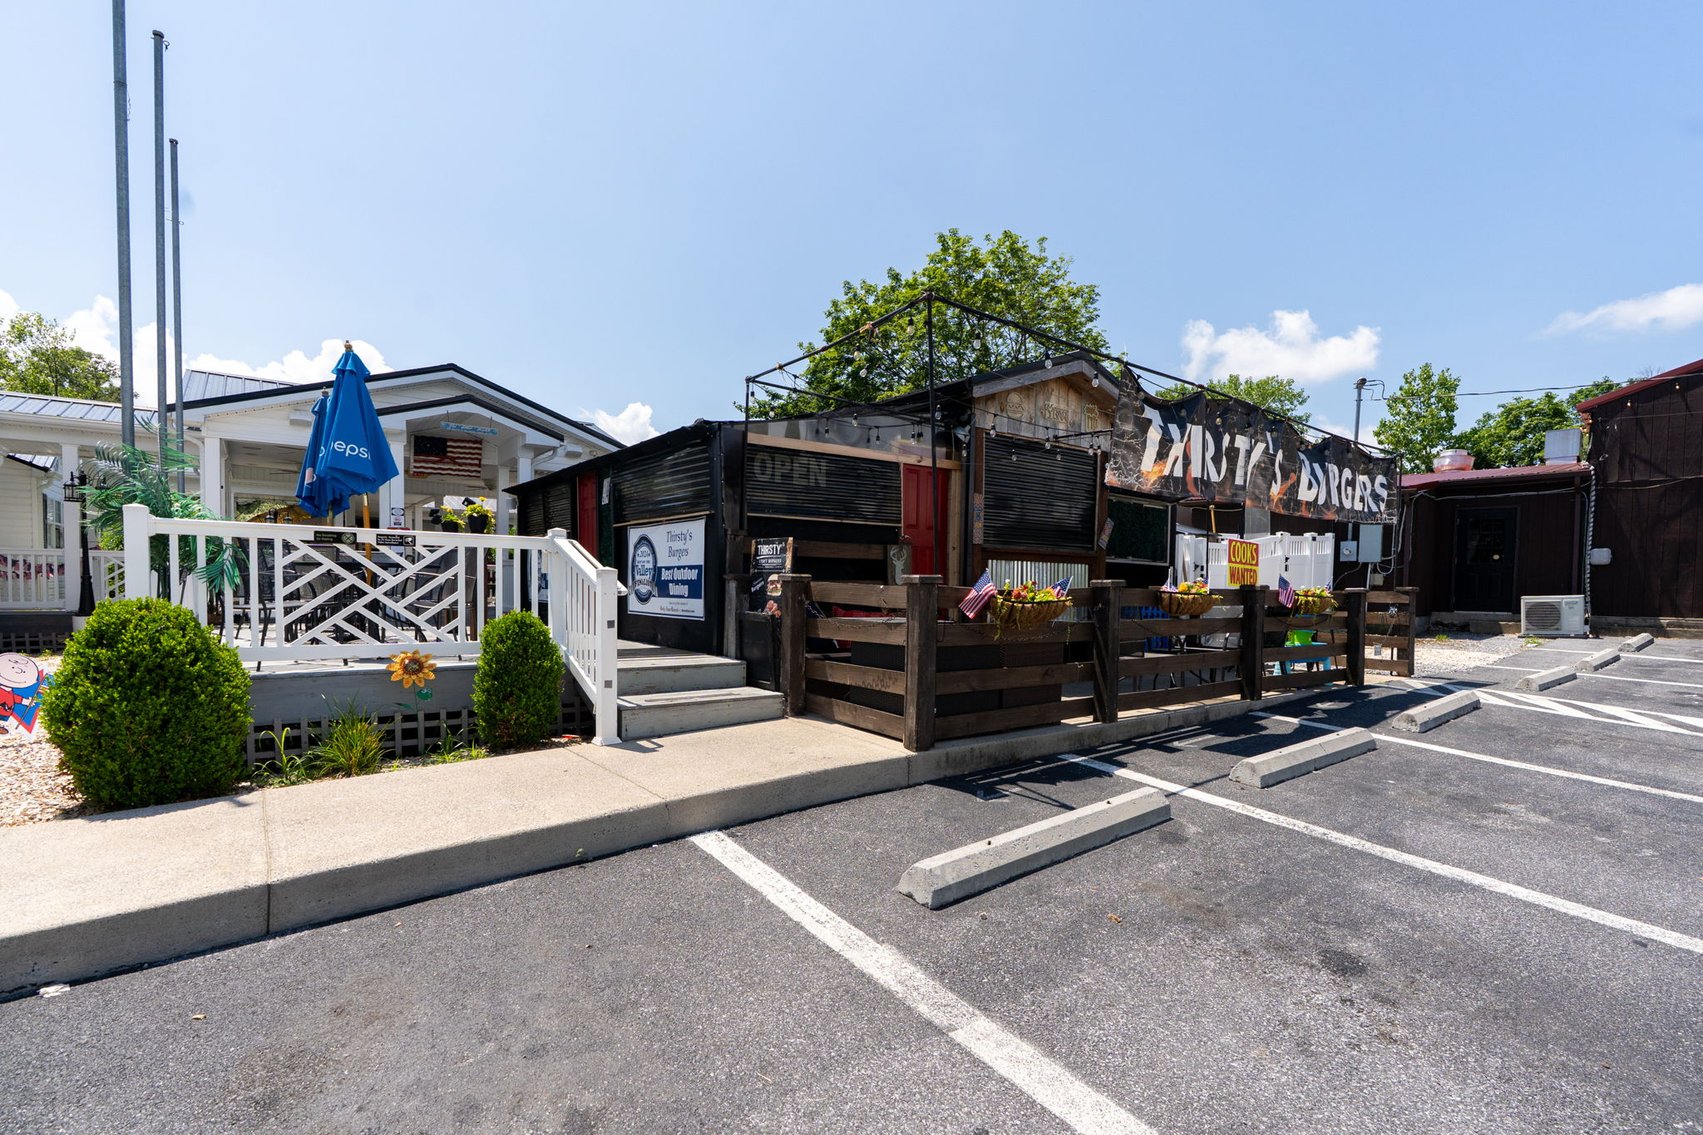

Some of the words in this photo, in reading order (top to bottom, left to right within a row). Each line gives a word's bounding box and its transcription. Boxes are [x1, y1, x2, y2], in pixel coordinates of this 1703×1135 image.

[330, 441, 371, 460] eps
[754, 452, 827, 487] OPEN
[666, 529, 693, 545] Thirsty's
[1230, 541, 1257, 565] COOKS
[635, 564, 654, 579] Valley
[661, 567, 673, 580] Best
[674, 567, 698, 580] Outdoor
[1229, 565, 1258, 586] WANTED
[668, 583, 689, 598] Dining
